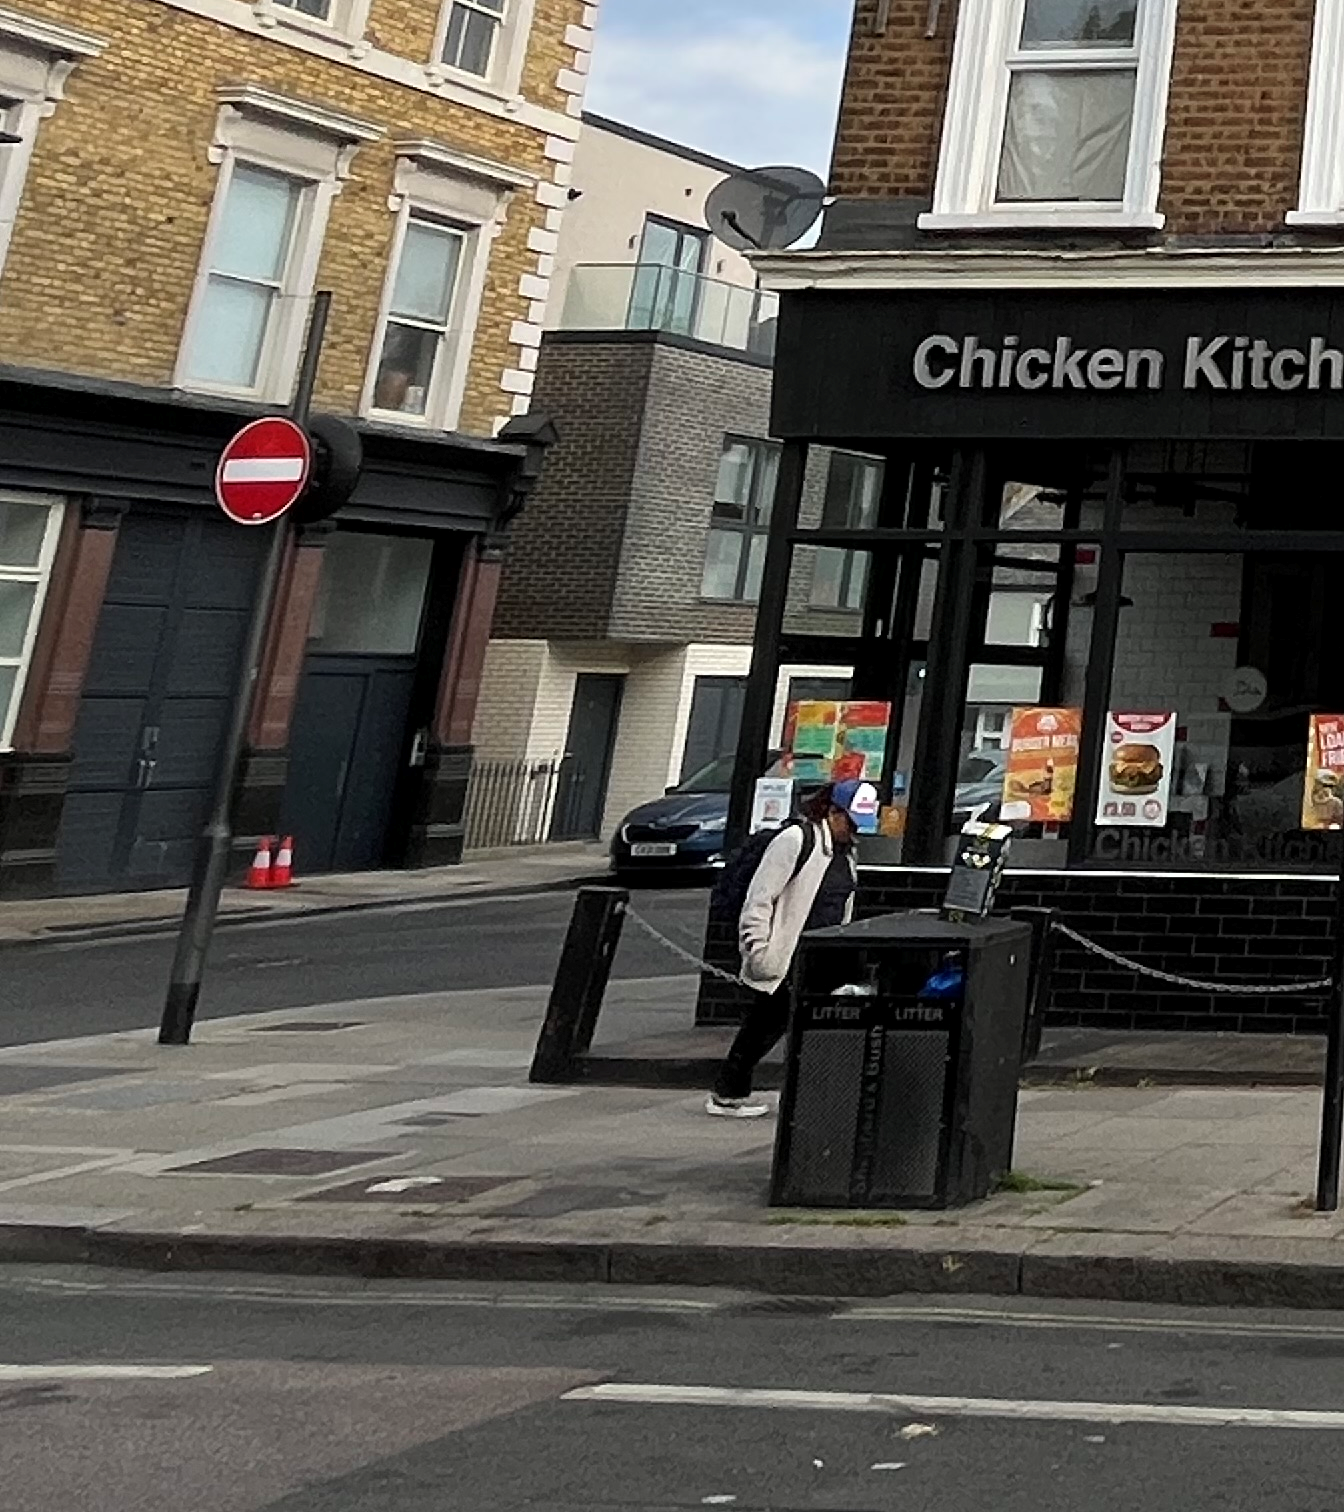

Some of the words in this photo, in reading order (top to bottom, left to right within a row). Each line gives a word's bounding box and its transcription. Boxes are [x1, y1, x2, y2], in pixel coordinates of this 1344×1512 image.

[913, 334, 1164, 390] Chicken
[812, 1006, 861, 1021] LITTER
[895, 1006, 944, 1022] LITTER
